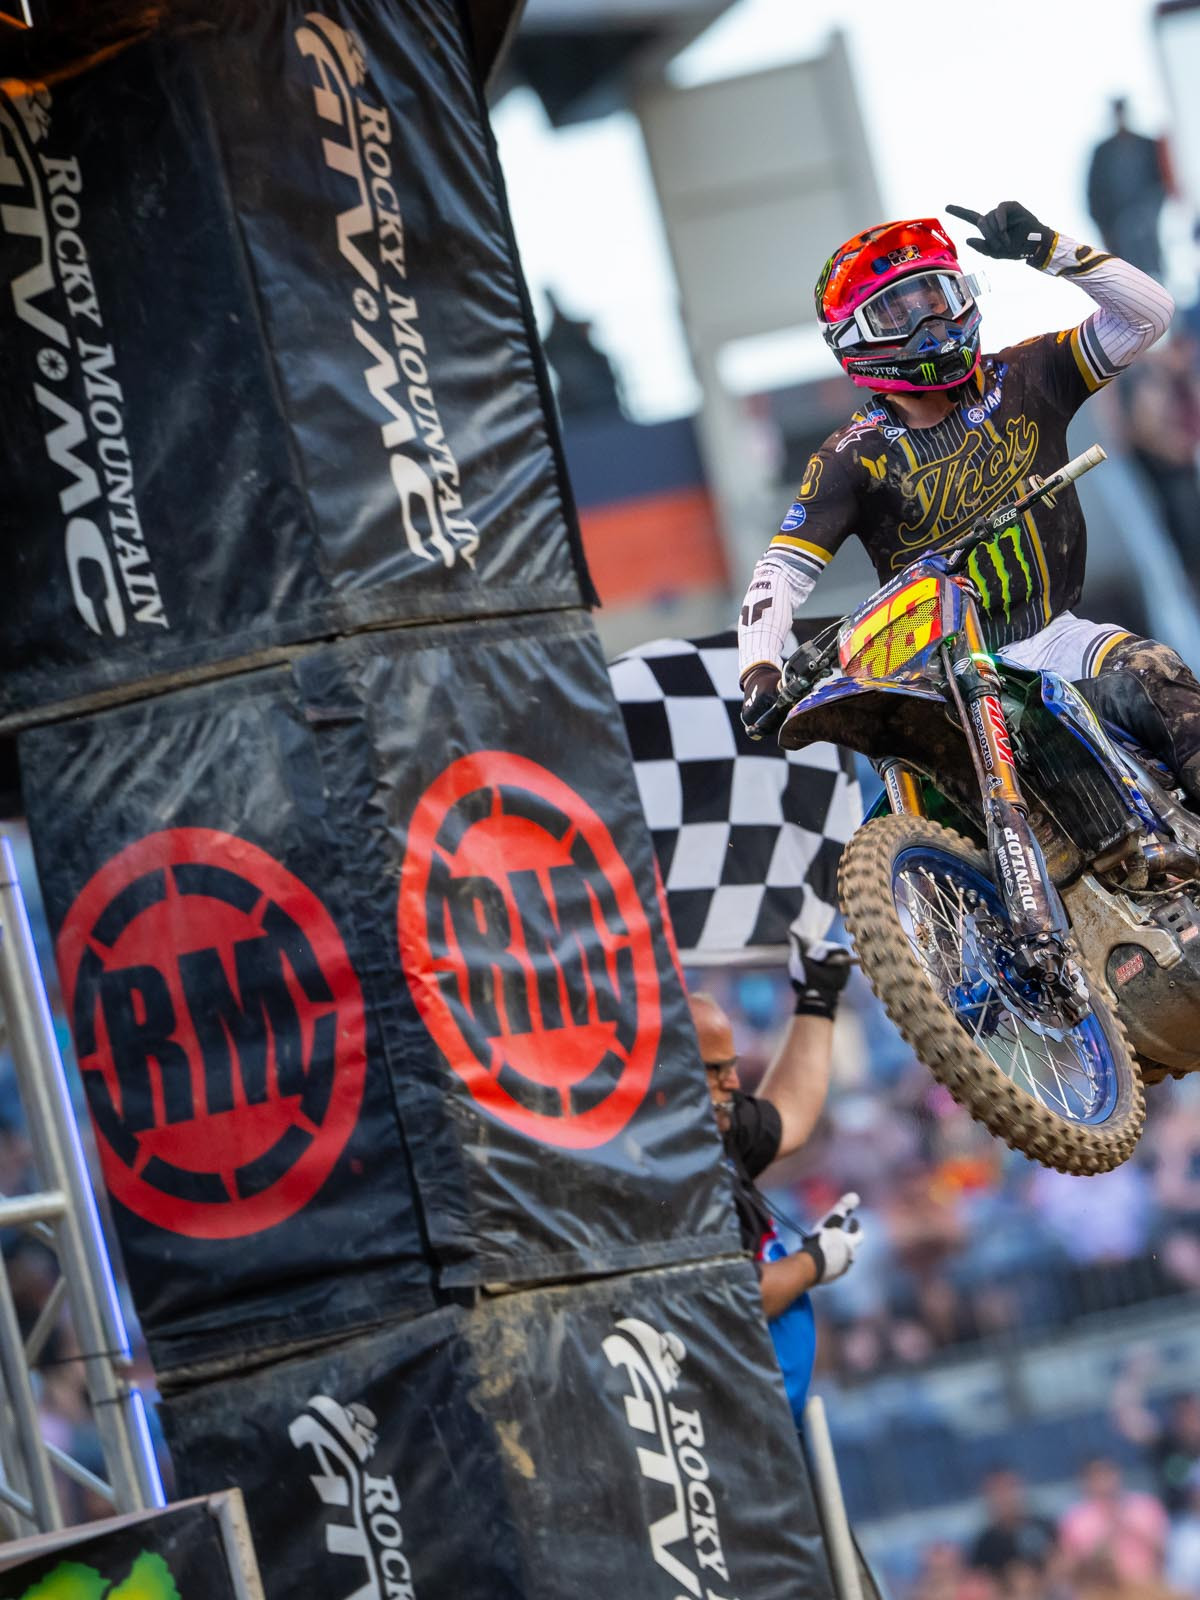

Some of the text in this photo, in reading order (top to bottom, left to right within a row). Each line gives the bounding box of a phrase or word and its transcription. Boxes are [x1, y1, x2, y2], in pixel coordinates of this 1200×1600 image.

[38, 152, 169, 629] ROCKY MOUNTAIN
[355, 97, 480, 570] ROCKY MOUNTAIN
[993, 508, 1018, 529] ARC
[998, 846, 1013, 879] CYCRA
[1004, 827, 1038, 911] DUNLOP
[666, 1402, 729, 1582] ROCKY
